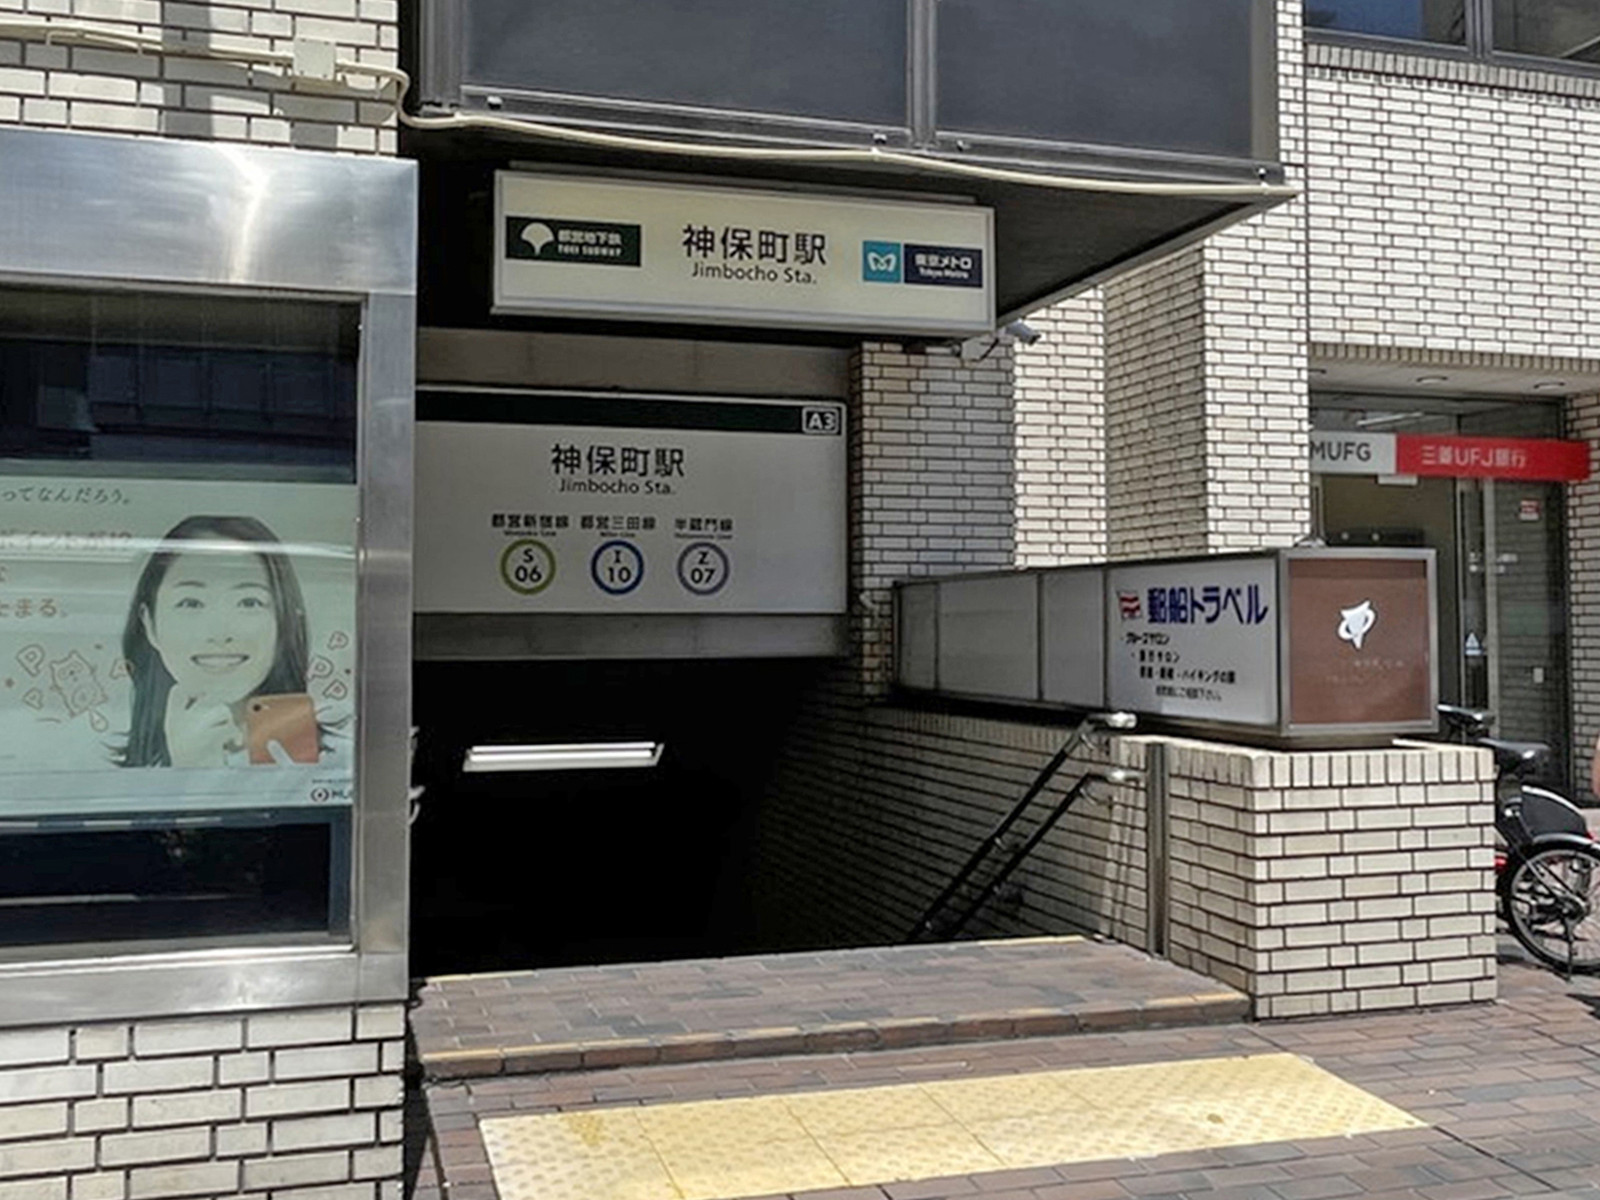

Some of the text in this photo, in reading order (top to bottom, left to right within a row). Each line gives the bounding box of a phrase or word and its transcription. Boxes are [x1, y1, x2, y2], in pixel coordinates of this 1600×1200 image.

[682, 223, 827, 265] 神保町駅
[692, 261, 818, 285] Jimbocho Sta.
[808, 412, 835, 430] A3
[551, 443, 685, 477] 神保町駅
[1310, 441, 1372, 462] MUFG
[560, 478, 677, 495] Jimbocho Sta.
[522, 548, 534, 564] S
[613, 550, 622, 564] I
[697, 551, 709, 565] Z
[514, 565, 542, 583] 06
[607, 566, 631, 583] 10
[690, 567, 716, 584] 07
[1147, 583, 1269, 625] 郵船トラベル
